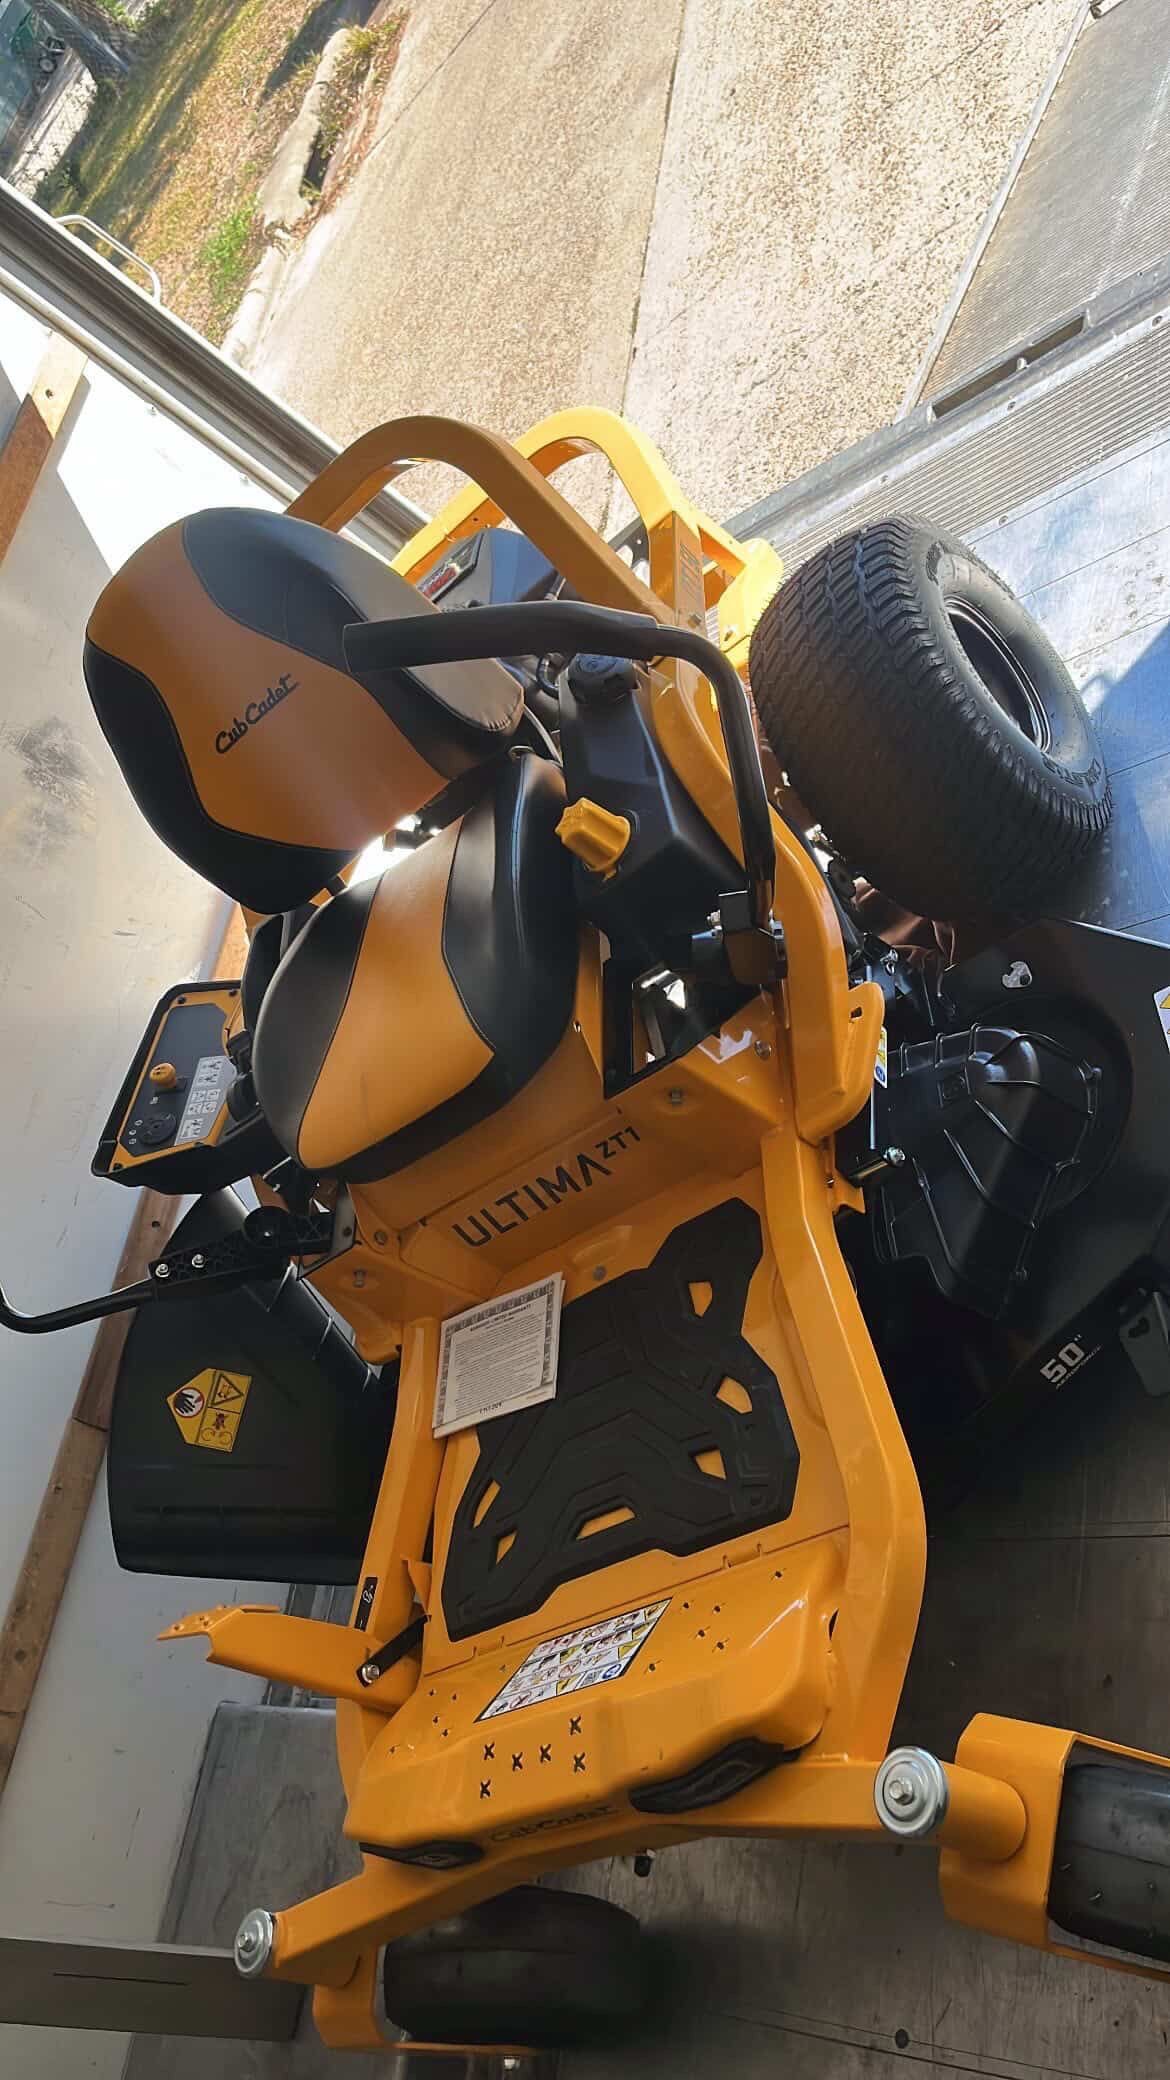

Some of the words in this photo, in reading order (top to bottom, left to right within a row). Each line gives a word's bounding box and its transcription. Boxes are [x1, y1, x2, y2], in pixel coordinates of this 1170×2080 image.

[215, 717, 248, 754] Cub
[245, 673, 299, 725] Cadet
[452, 1153, 613, 1247] ULTIMA
[595, 1126, 641, 1160] ZT1
